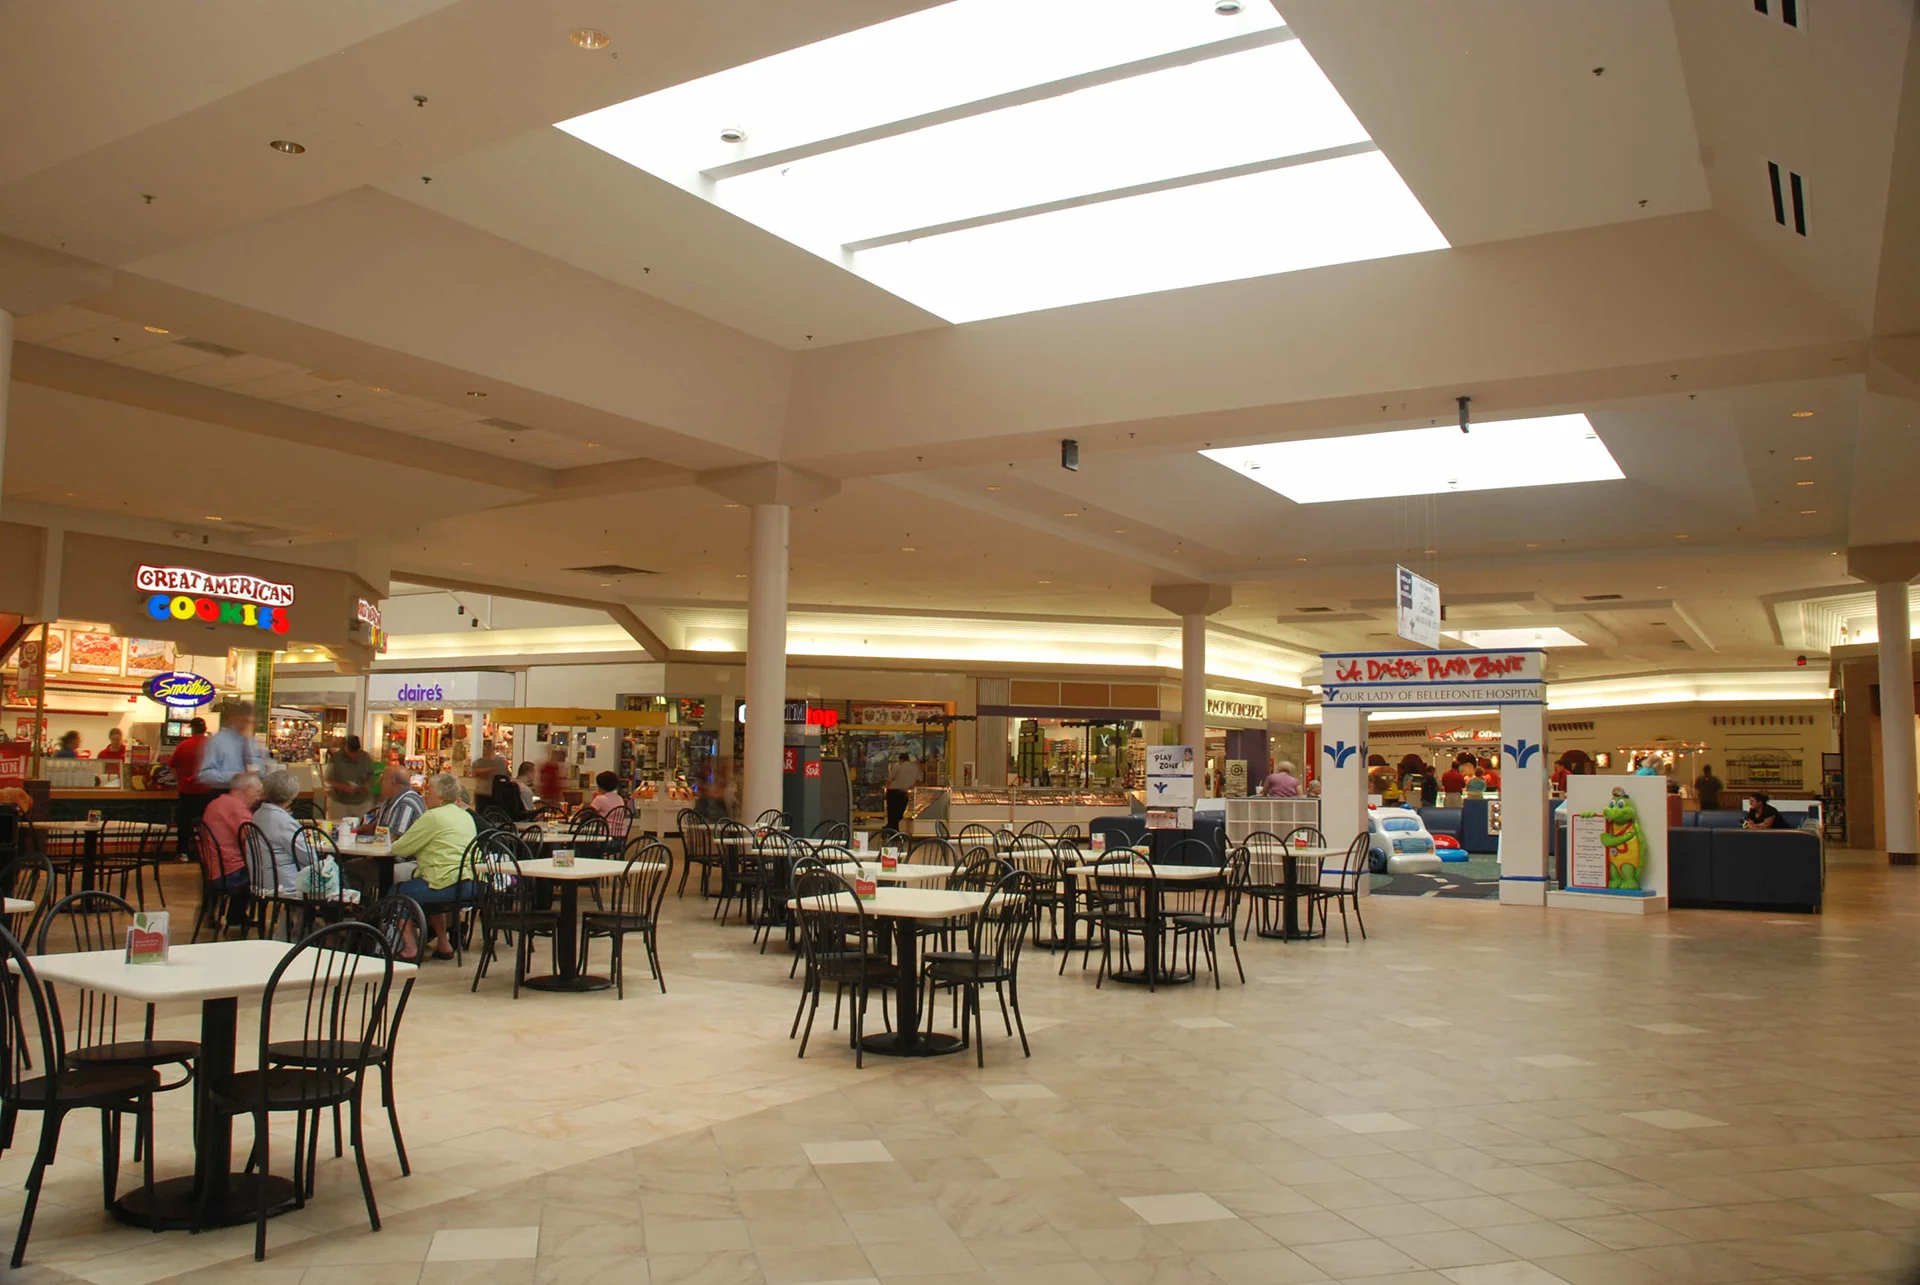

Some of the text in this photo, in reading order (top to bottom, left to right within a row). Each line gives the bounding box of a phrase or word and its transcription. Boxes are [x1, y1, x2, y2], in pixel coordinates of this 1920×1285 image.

[139, 570, 293, 604] GREAT AMERICAN
[147, 593, 291, 635] COOKIES
[397, 683, 443, 701] claire's
[1339, 688, 1541, 702] OUR LADY OF BELLEFONTE HOSPITAL
[783, 703, 806, 721] TM
[1452, 728, 1493, 741] verizon
[1154, 754, 1172, 762] PLAY
[1159, 762, 1179, 770] ZONE
